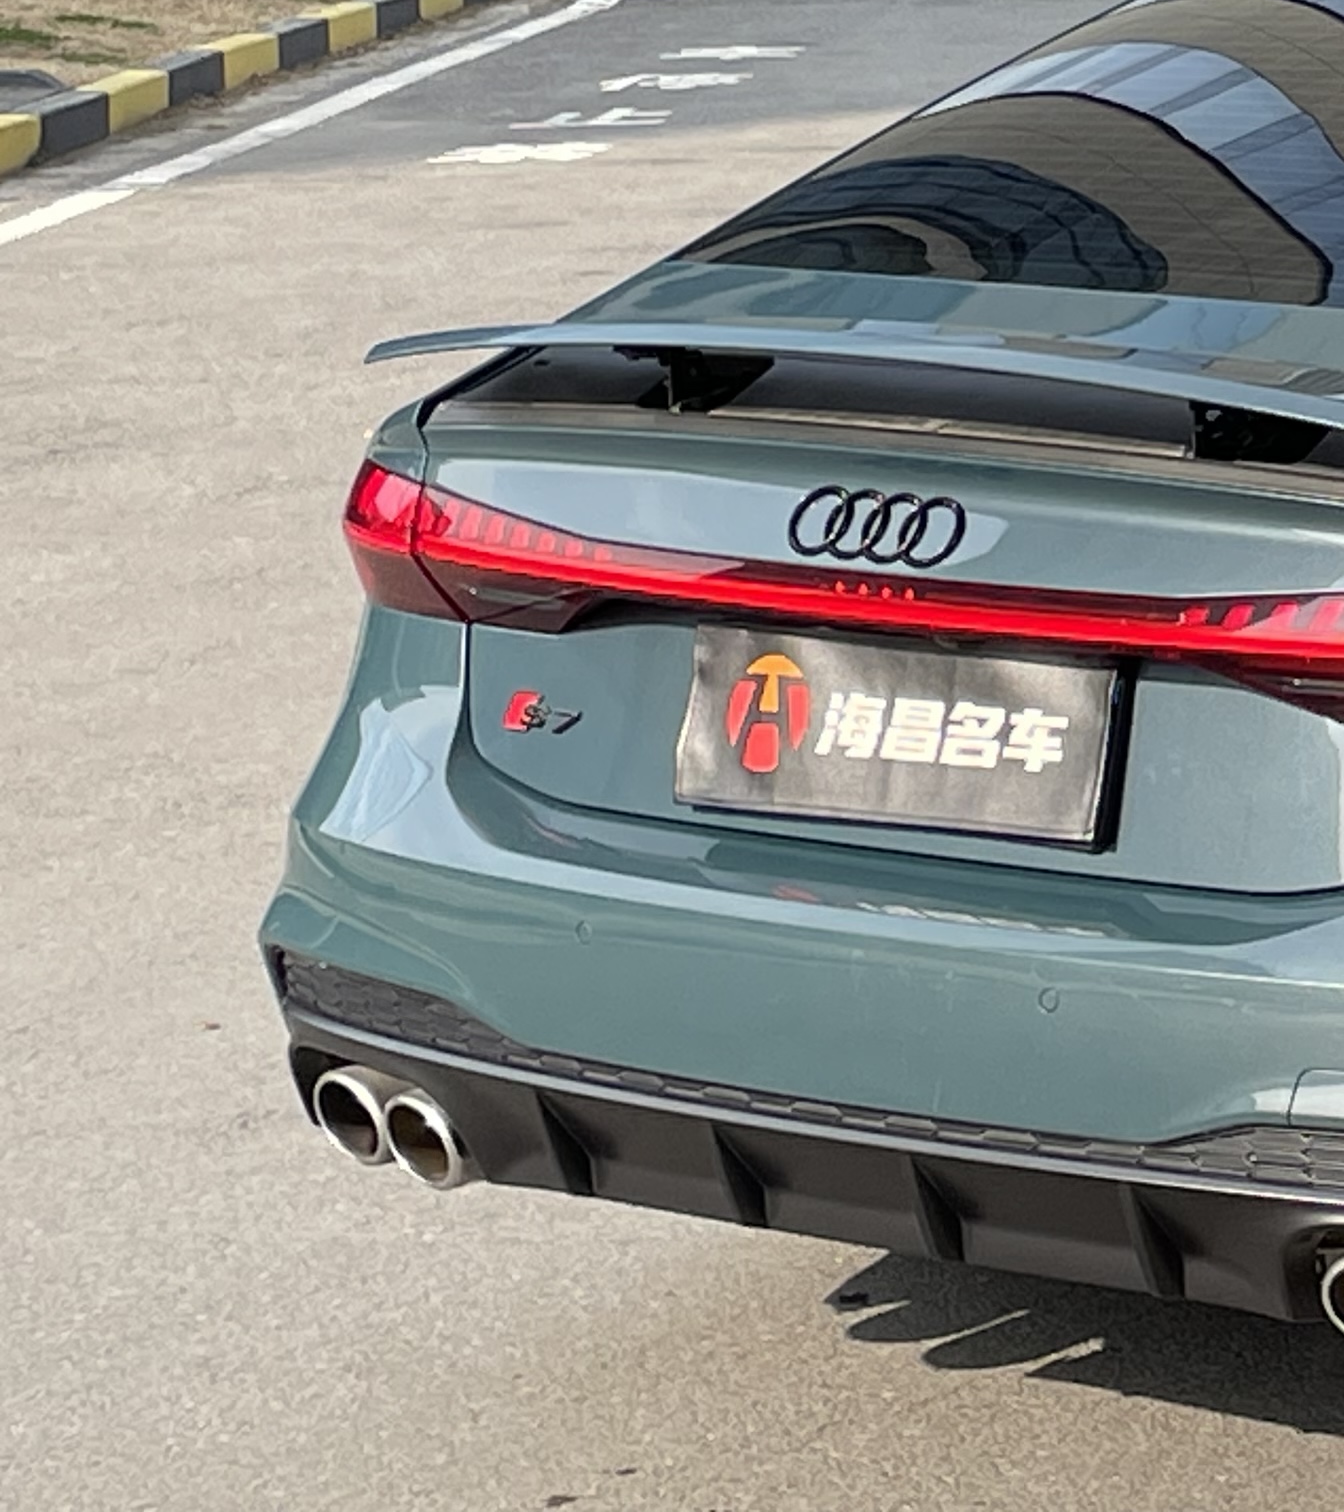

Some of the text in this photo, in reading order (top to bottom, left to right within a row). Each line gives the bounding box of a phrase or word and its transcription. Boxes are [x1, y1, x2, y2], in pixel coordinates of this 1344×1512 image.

[502, 691, 582, 734] S7
[813, 692, 1069, 773] 海昌名车
